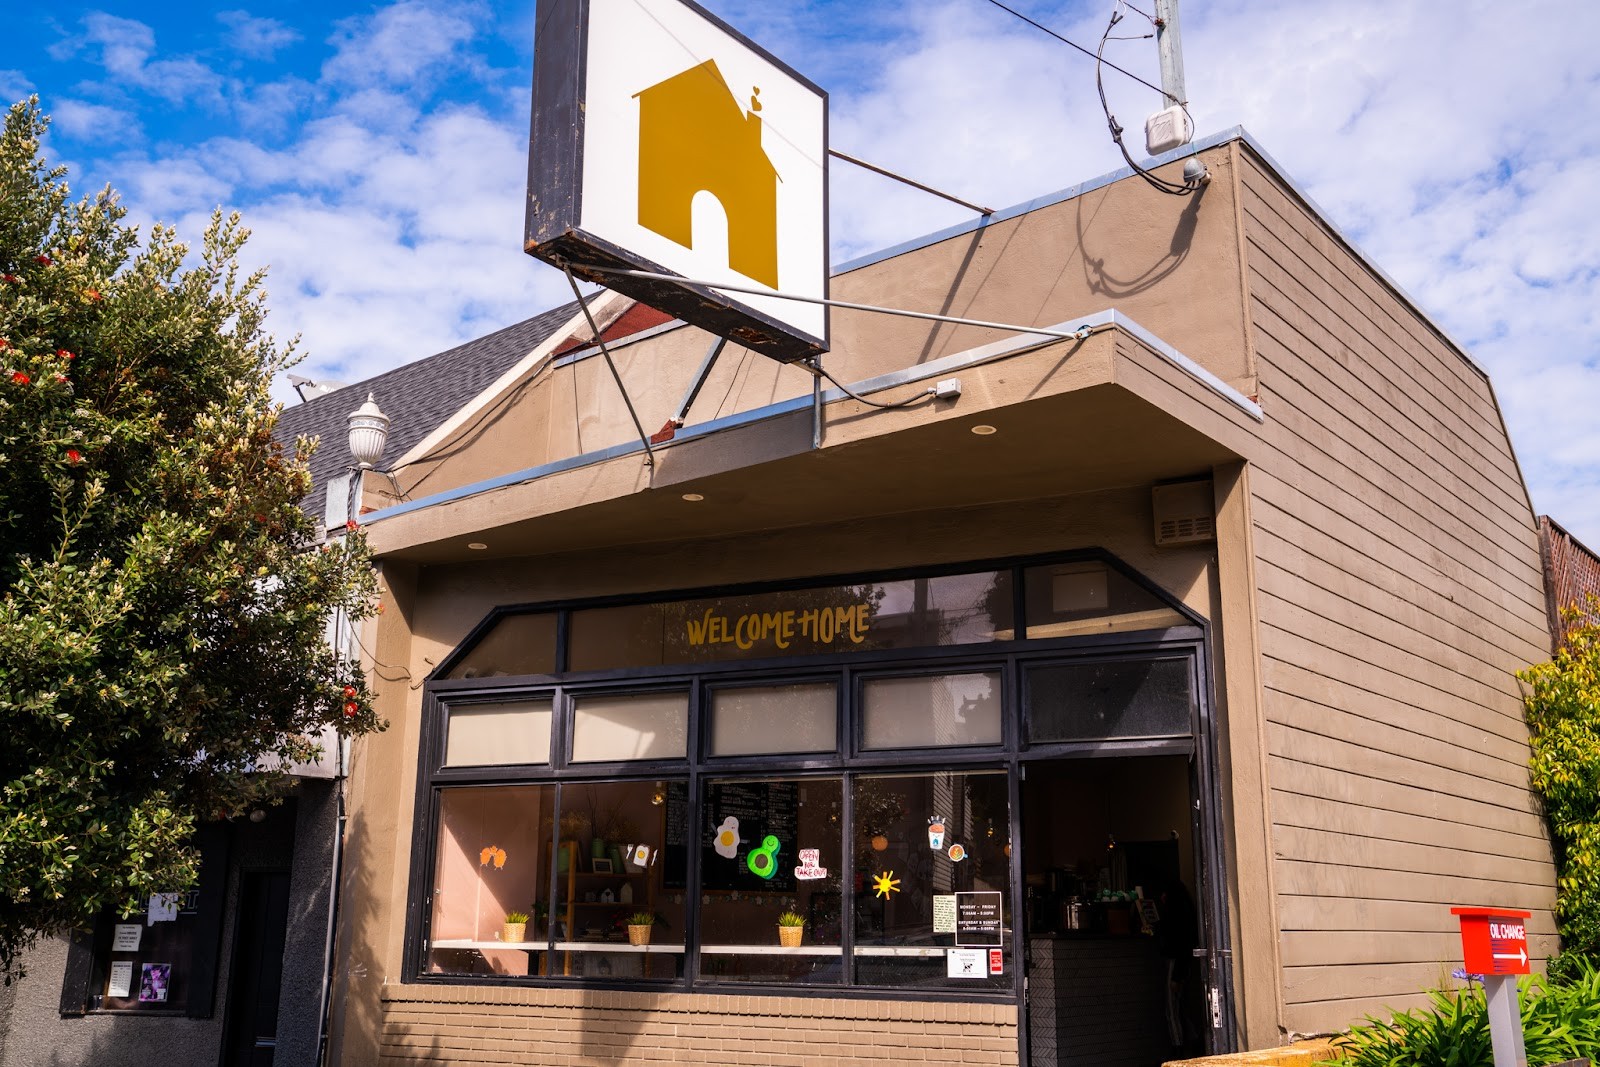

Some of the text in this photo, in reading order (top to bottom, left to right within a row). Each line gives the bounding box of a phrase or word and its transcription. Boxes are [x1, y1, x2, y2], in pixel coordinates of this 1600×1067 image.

[686, 603, 870, 650] WELCOME HOME
[800, 850, 819, 861] OPEN
[796, 868, 813, 877] TAKE
[1490, 923, 1525, 940] OIL CHANGE
